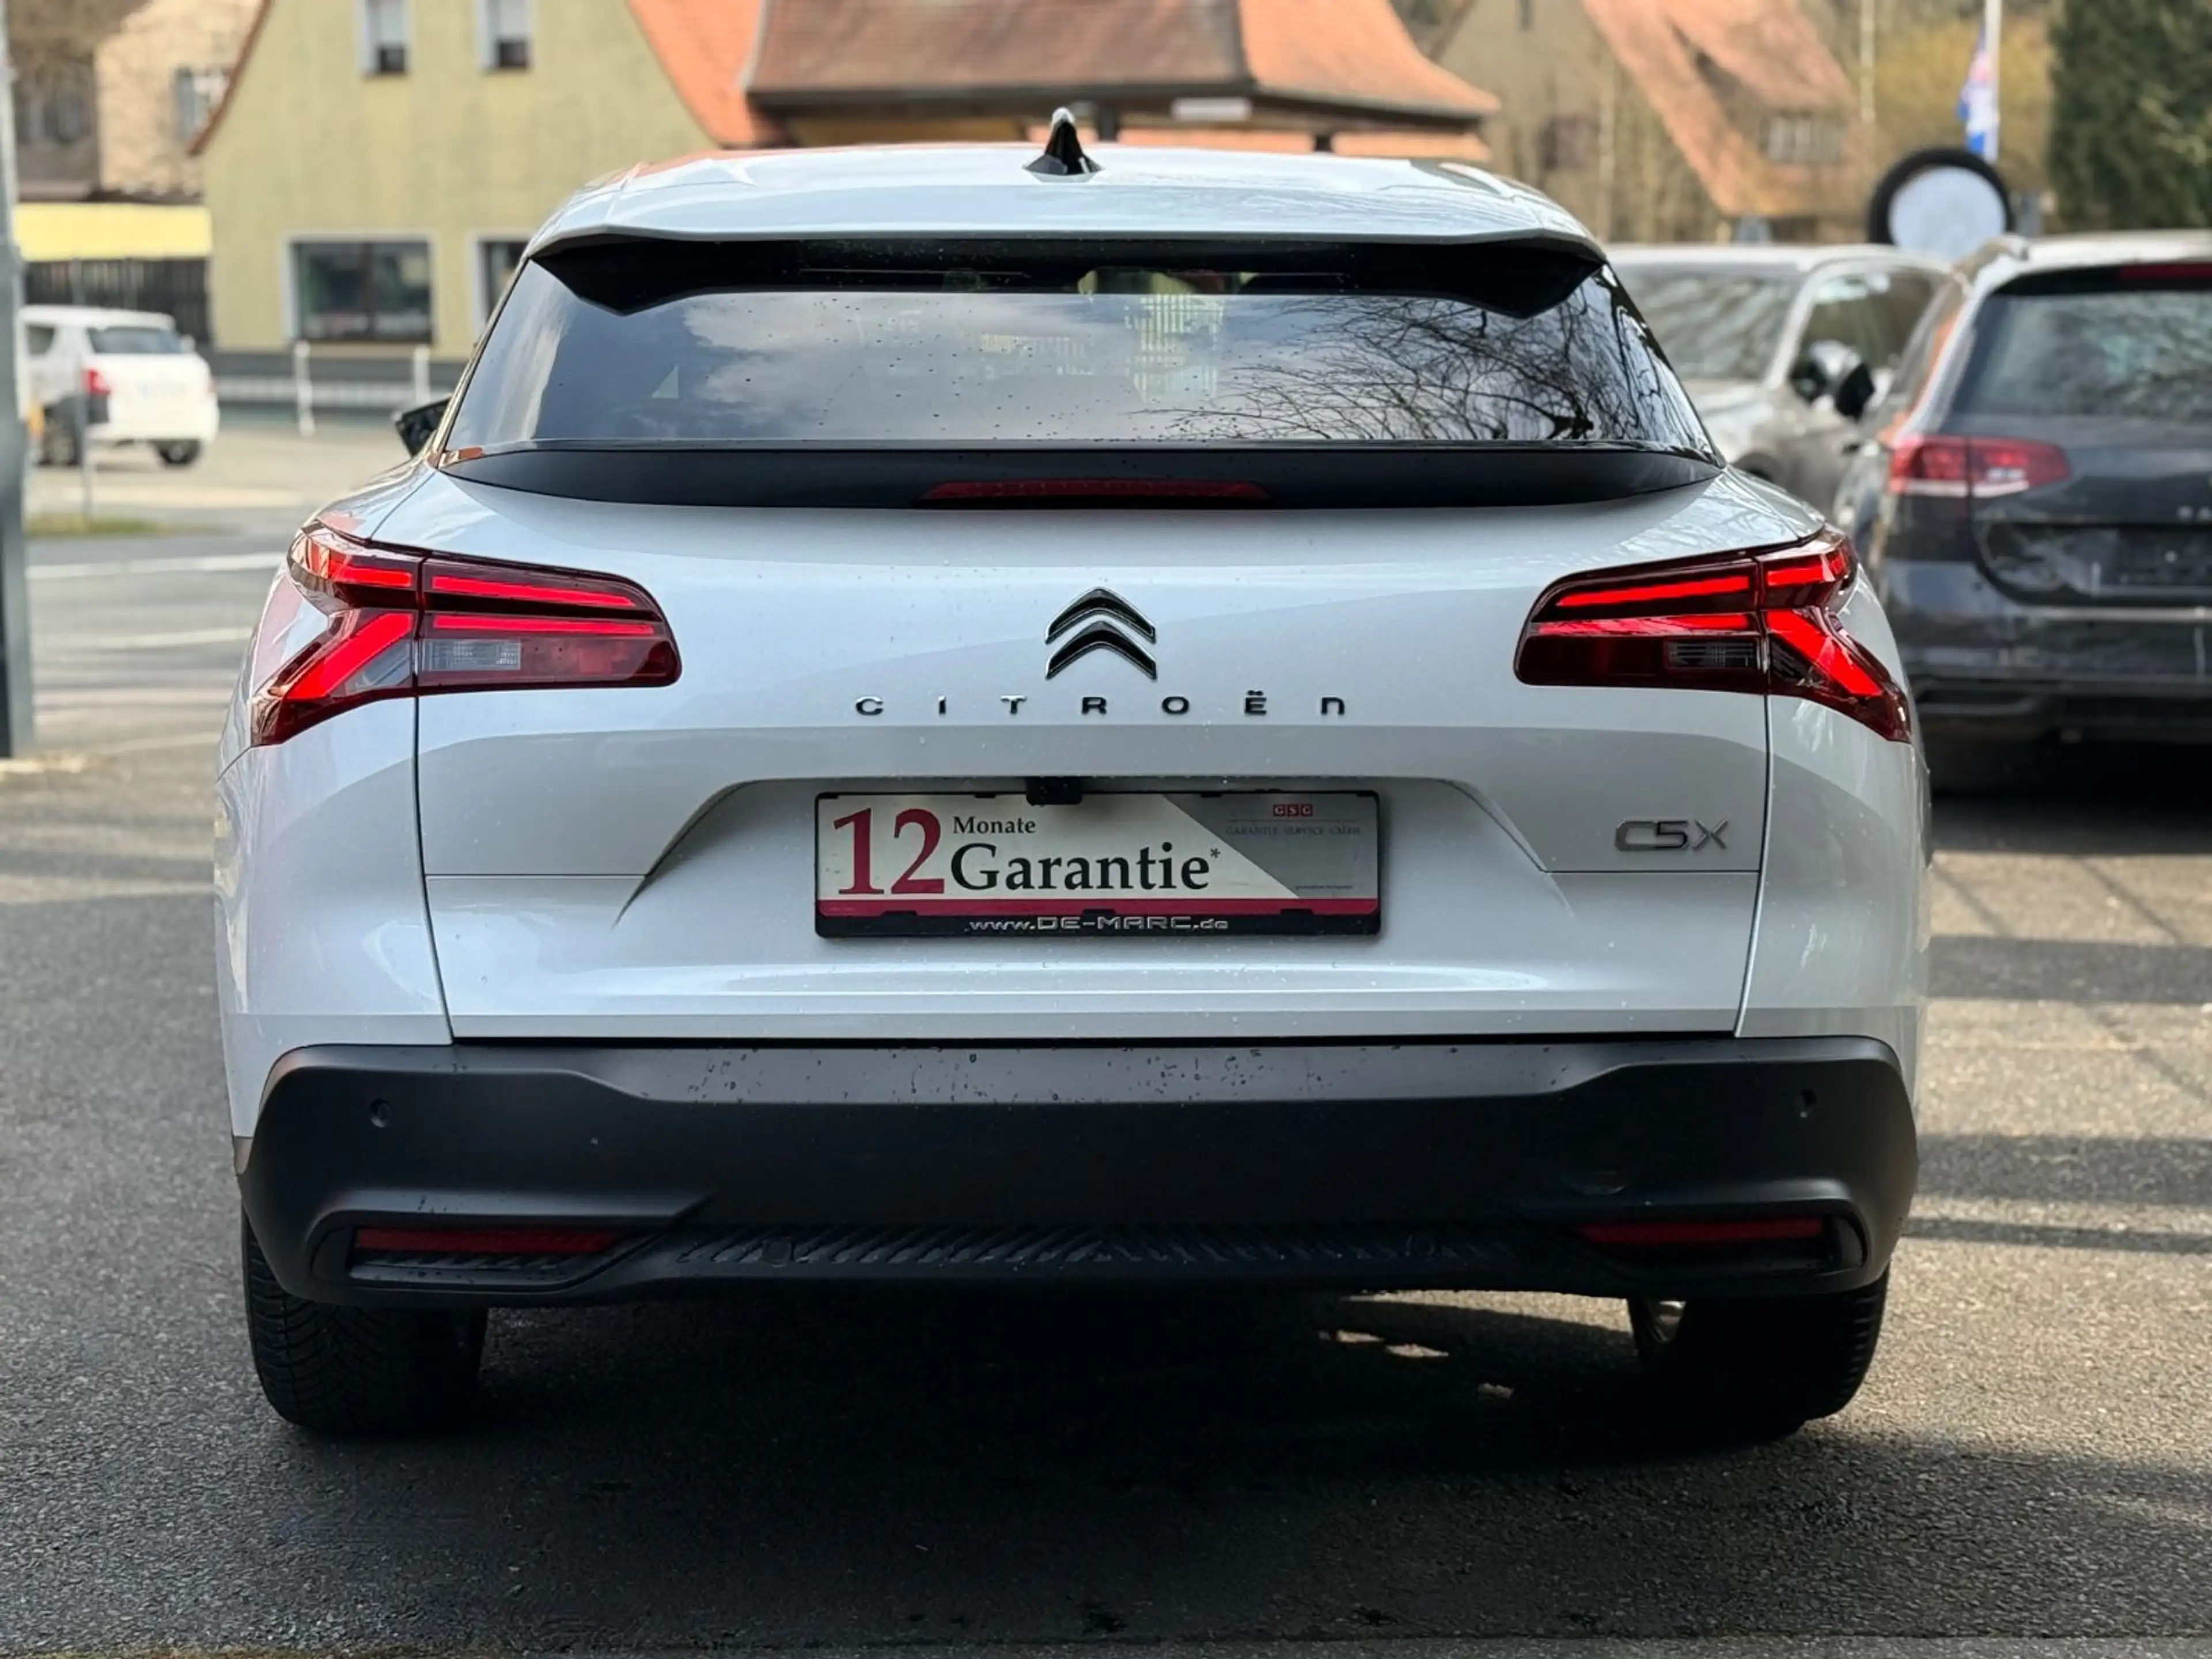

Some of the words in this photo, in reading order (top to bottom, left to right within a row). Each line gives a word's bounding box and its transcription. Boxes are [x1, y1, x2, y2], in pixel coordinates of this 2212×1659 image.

[953, 816, 1036, 834] Monate
[834, 808, 945, 893] 12
[969, 916, 1229, 929] www.DE-MARC.de
